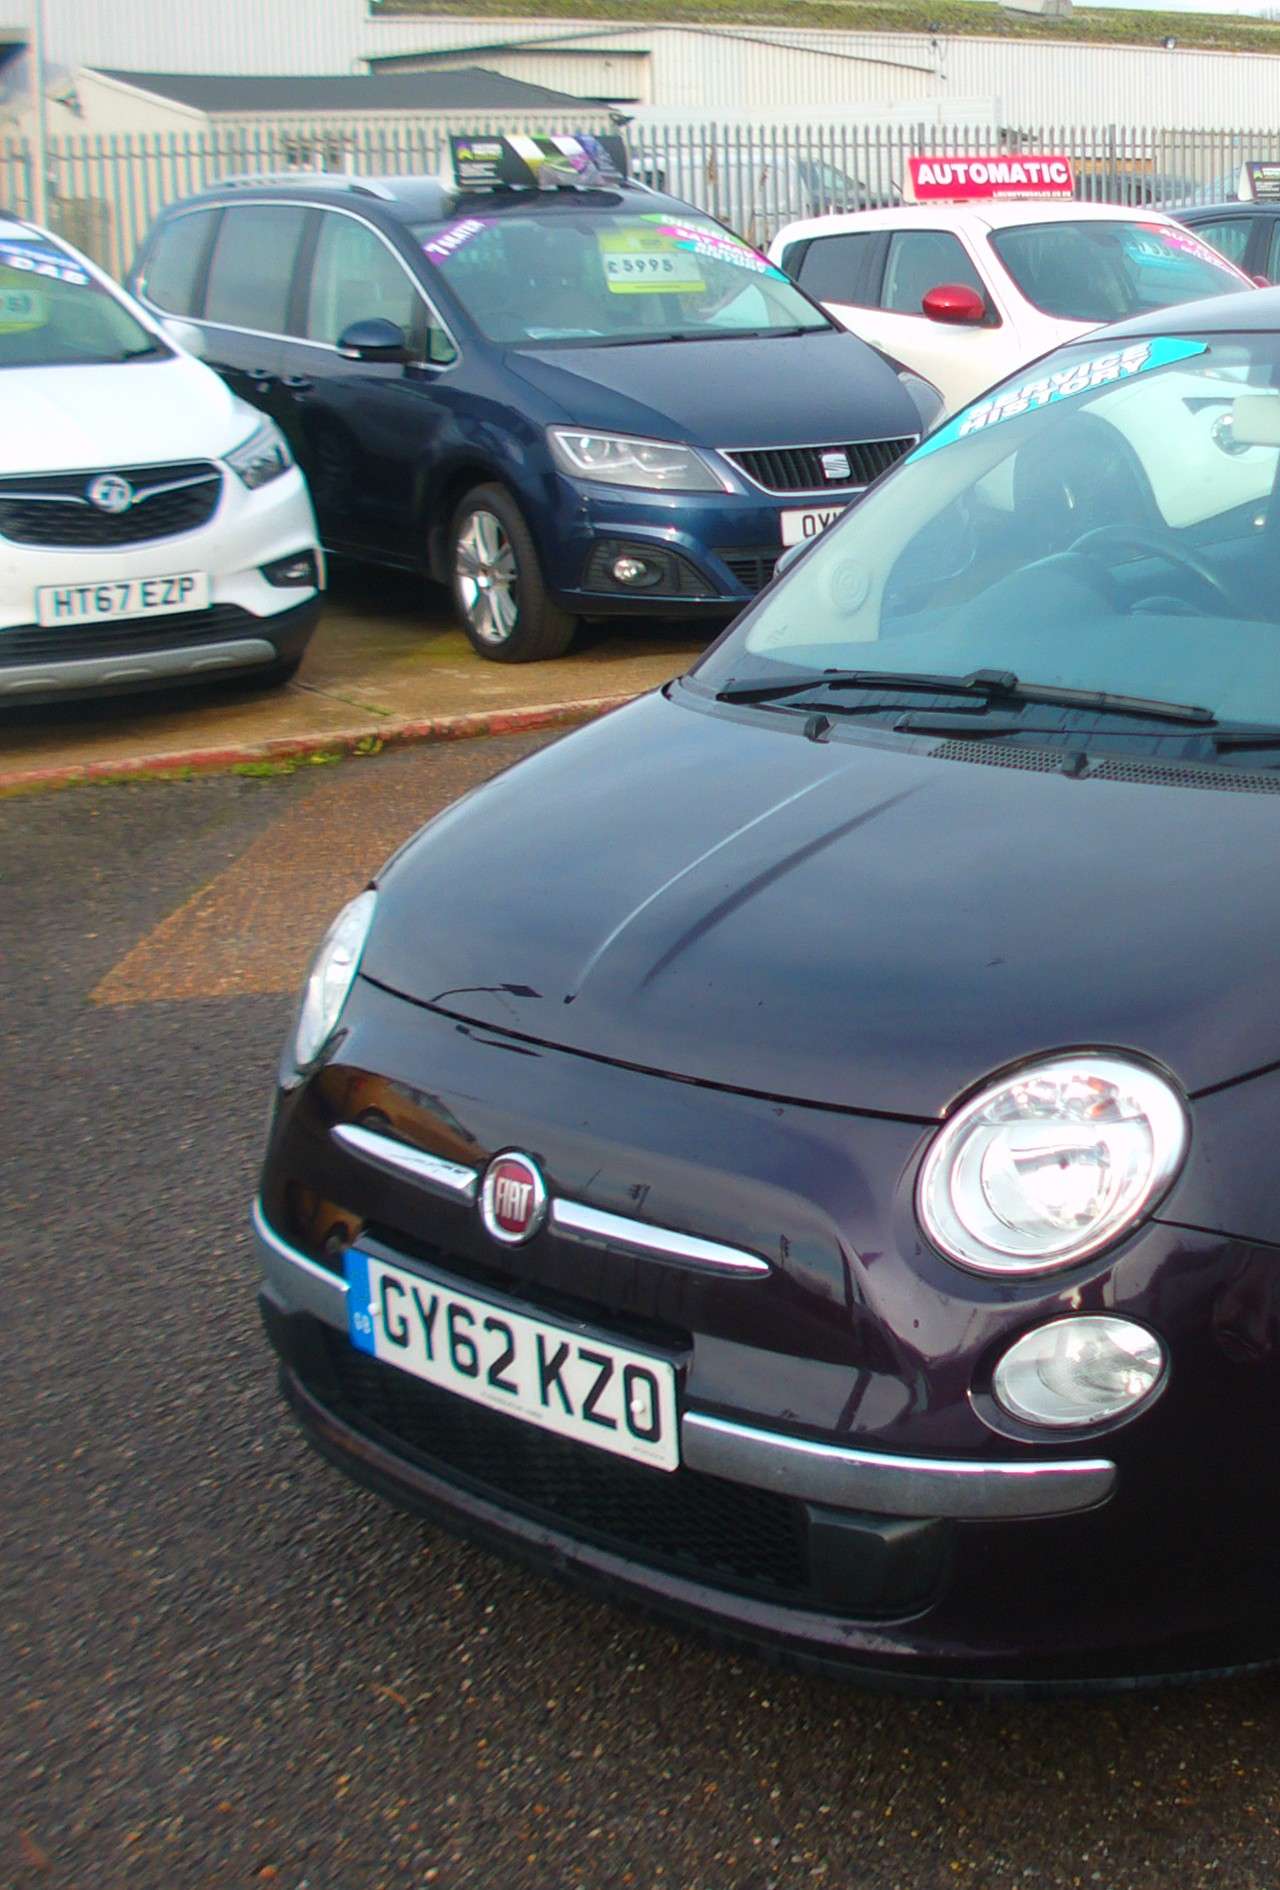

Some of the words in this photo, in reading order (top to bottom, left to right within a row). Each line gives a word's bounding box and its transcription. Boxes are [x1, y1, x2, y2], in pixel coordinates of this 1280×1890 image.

[917, 162, 1068, 185] AUTOMATIC
[959, 352, 1150, 437] HISTORY
[968, 340, 1151, 419] SERVICE
[53, 584, 131, 618] HT67
[140, 576, 195, 608] EZP
[496, 1176, 533, 1223] FIAT
[380, 1272, 519, 1396] GY62
